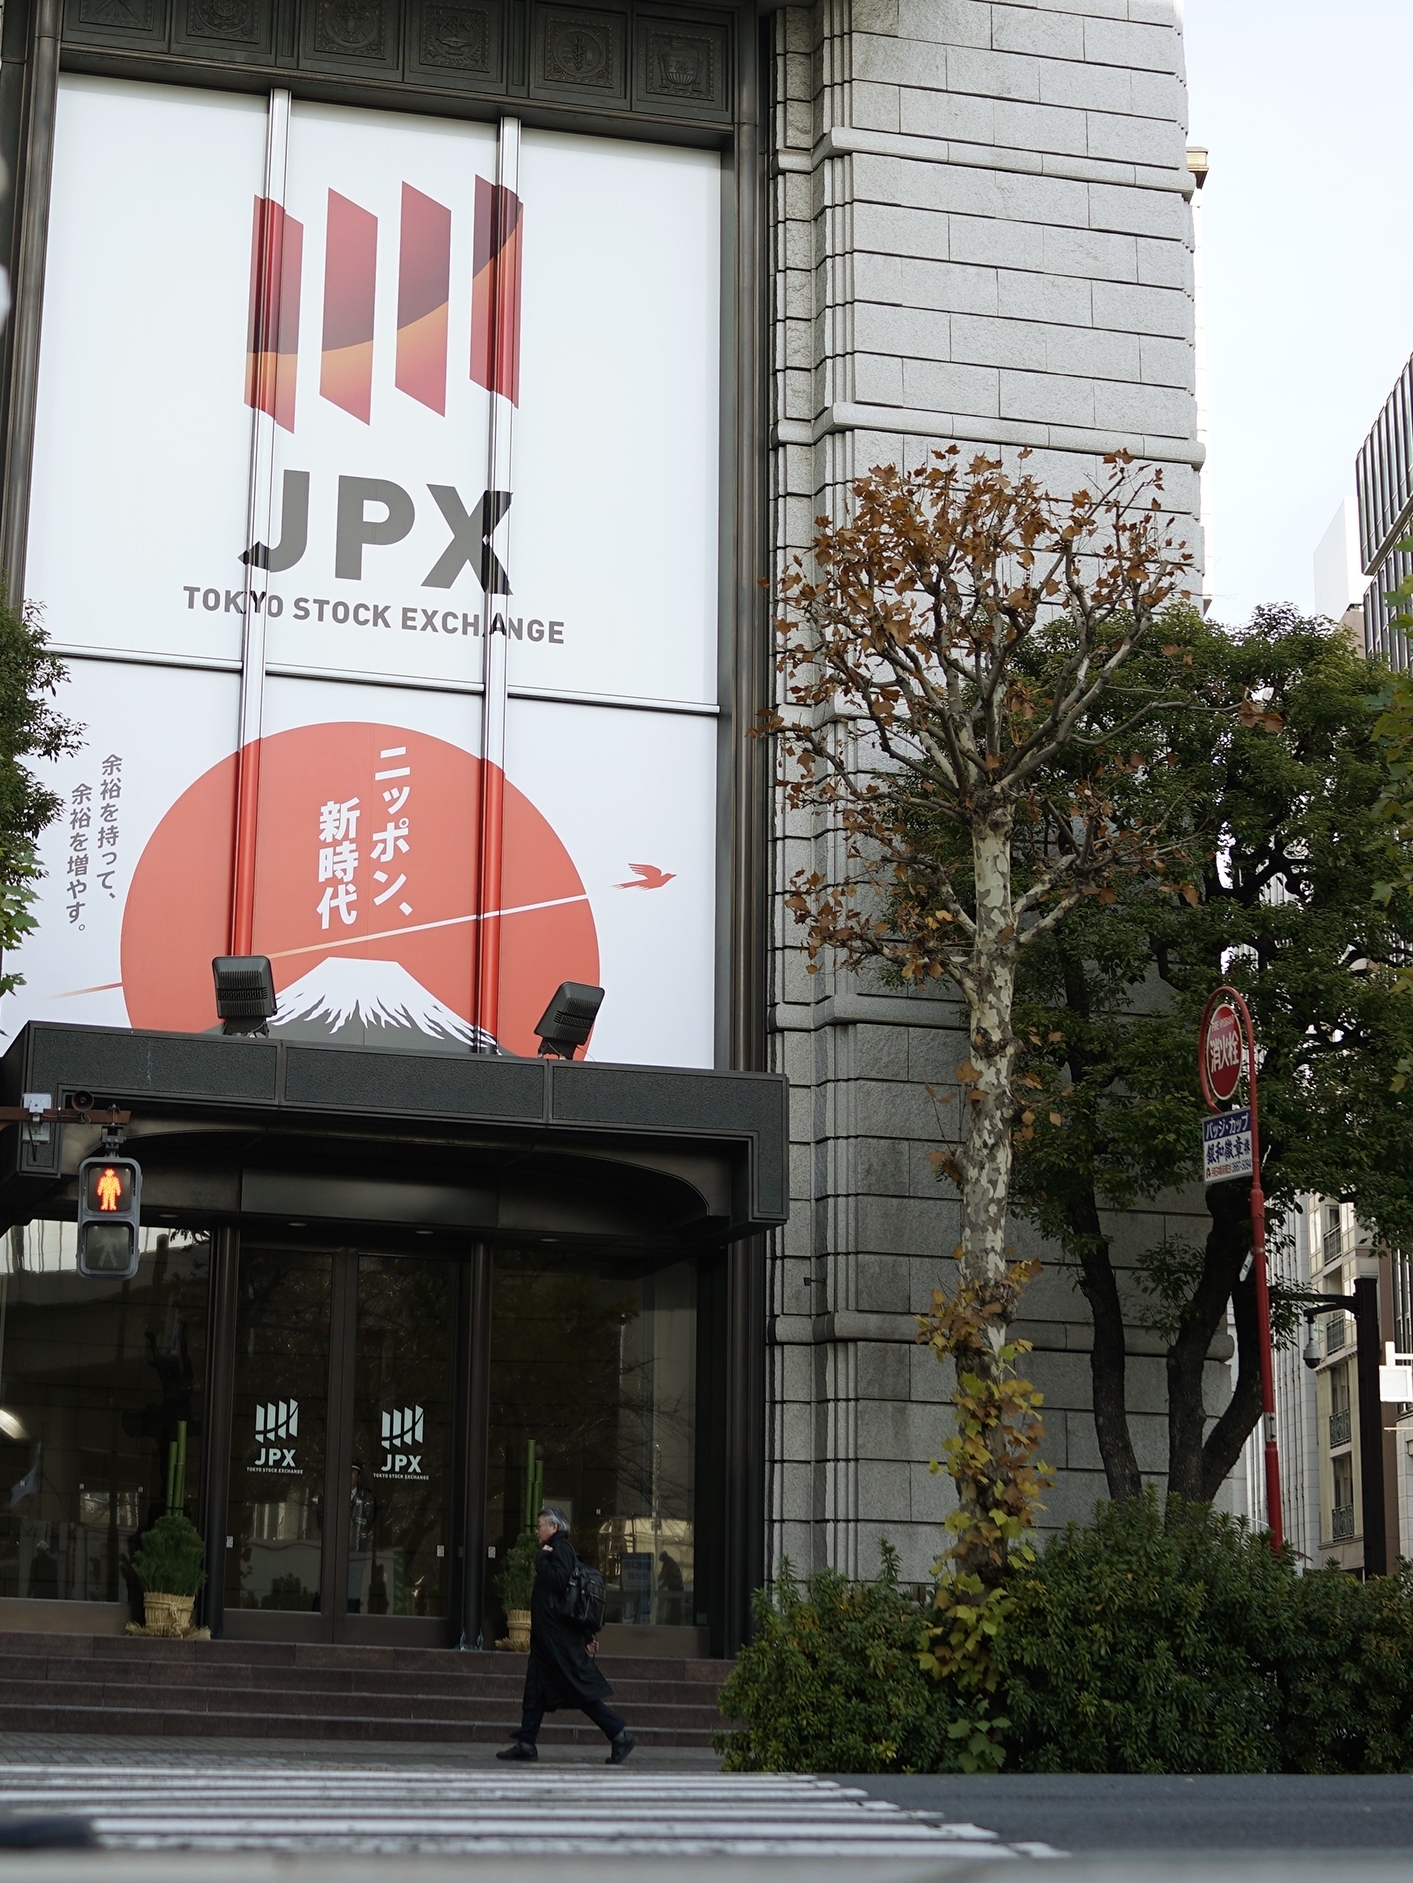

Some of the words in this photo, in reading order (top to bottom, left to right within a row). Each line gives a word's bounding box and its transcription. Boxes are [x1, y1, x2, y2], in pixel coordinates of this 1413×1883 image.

[238, 469, 514, 596] JPX
[183, 585, 284, 618] TOKYO
[292, 597, 391, 629] STOCK
[401, 607, 565, 645] EXCHANGE
[65, 783, 93, 931] 余裕を増やす。
[96, 753, 123, 899] 余裕を持って、
[316, 796, 361, 930] 新時代
[369, 746, 413, 916] ニッポン、
[1209, 1030, 1239, 1074] 消火栓
[254, 1447, 297, 1467] JPX
[381, 1454, 422, 1473] JPX
